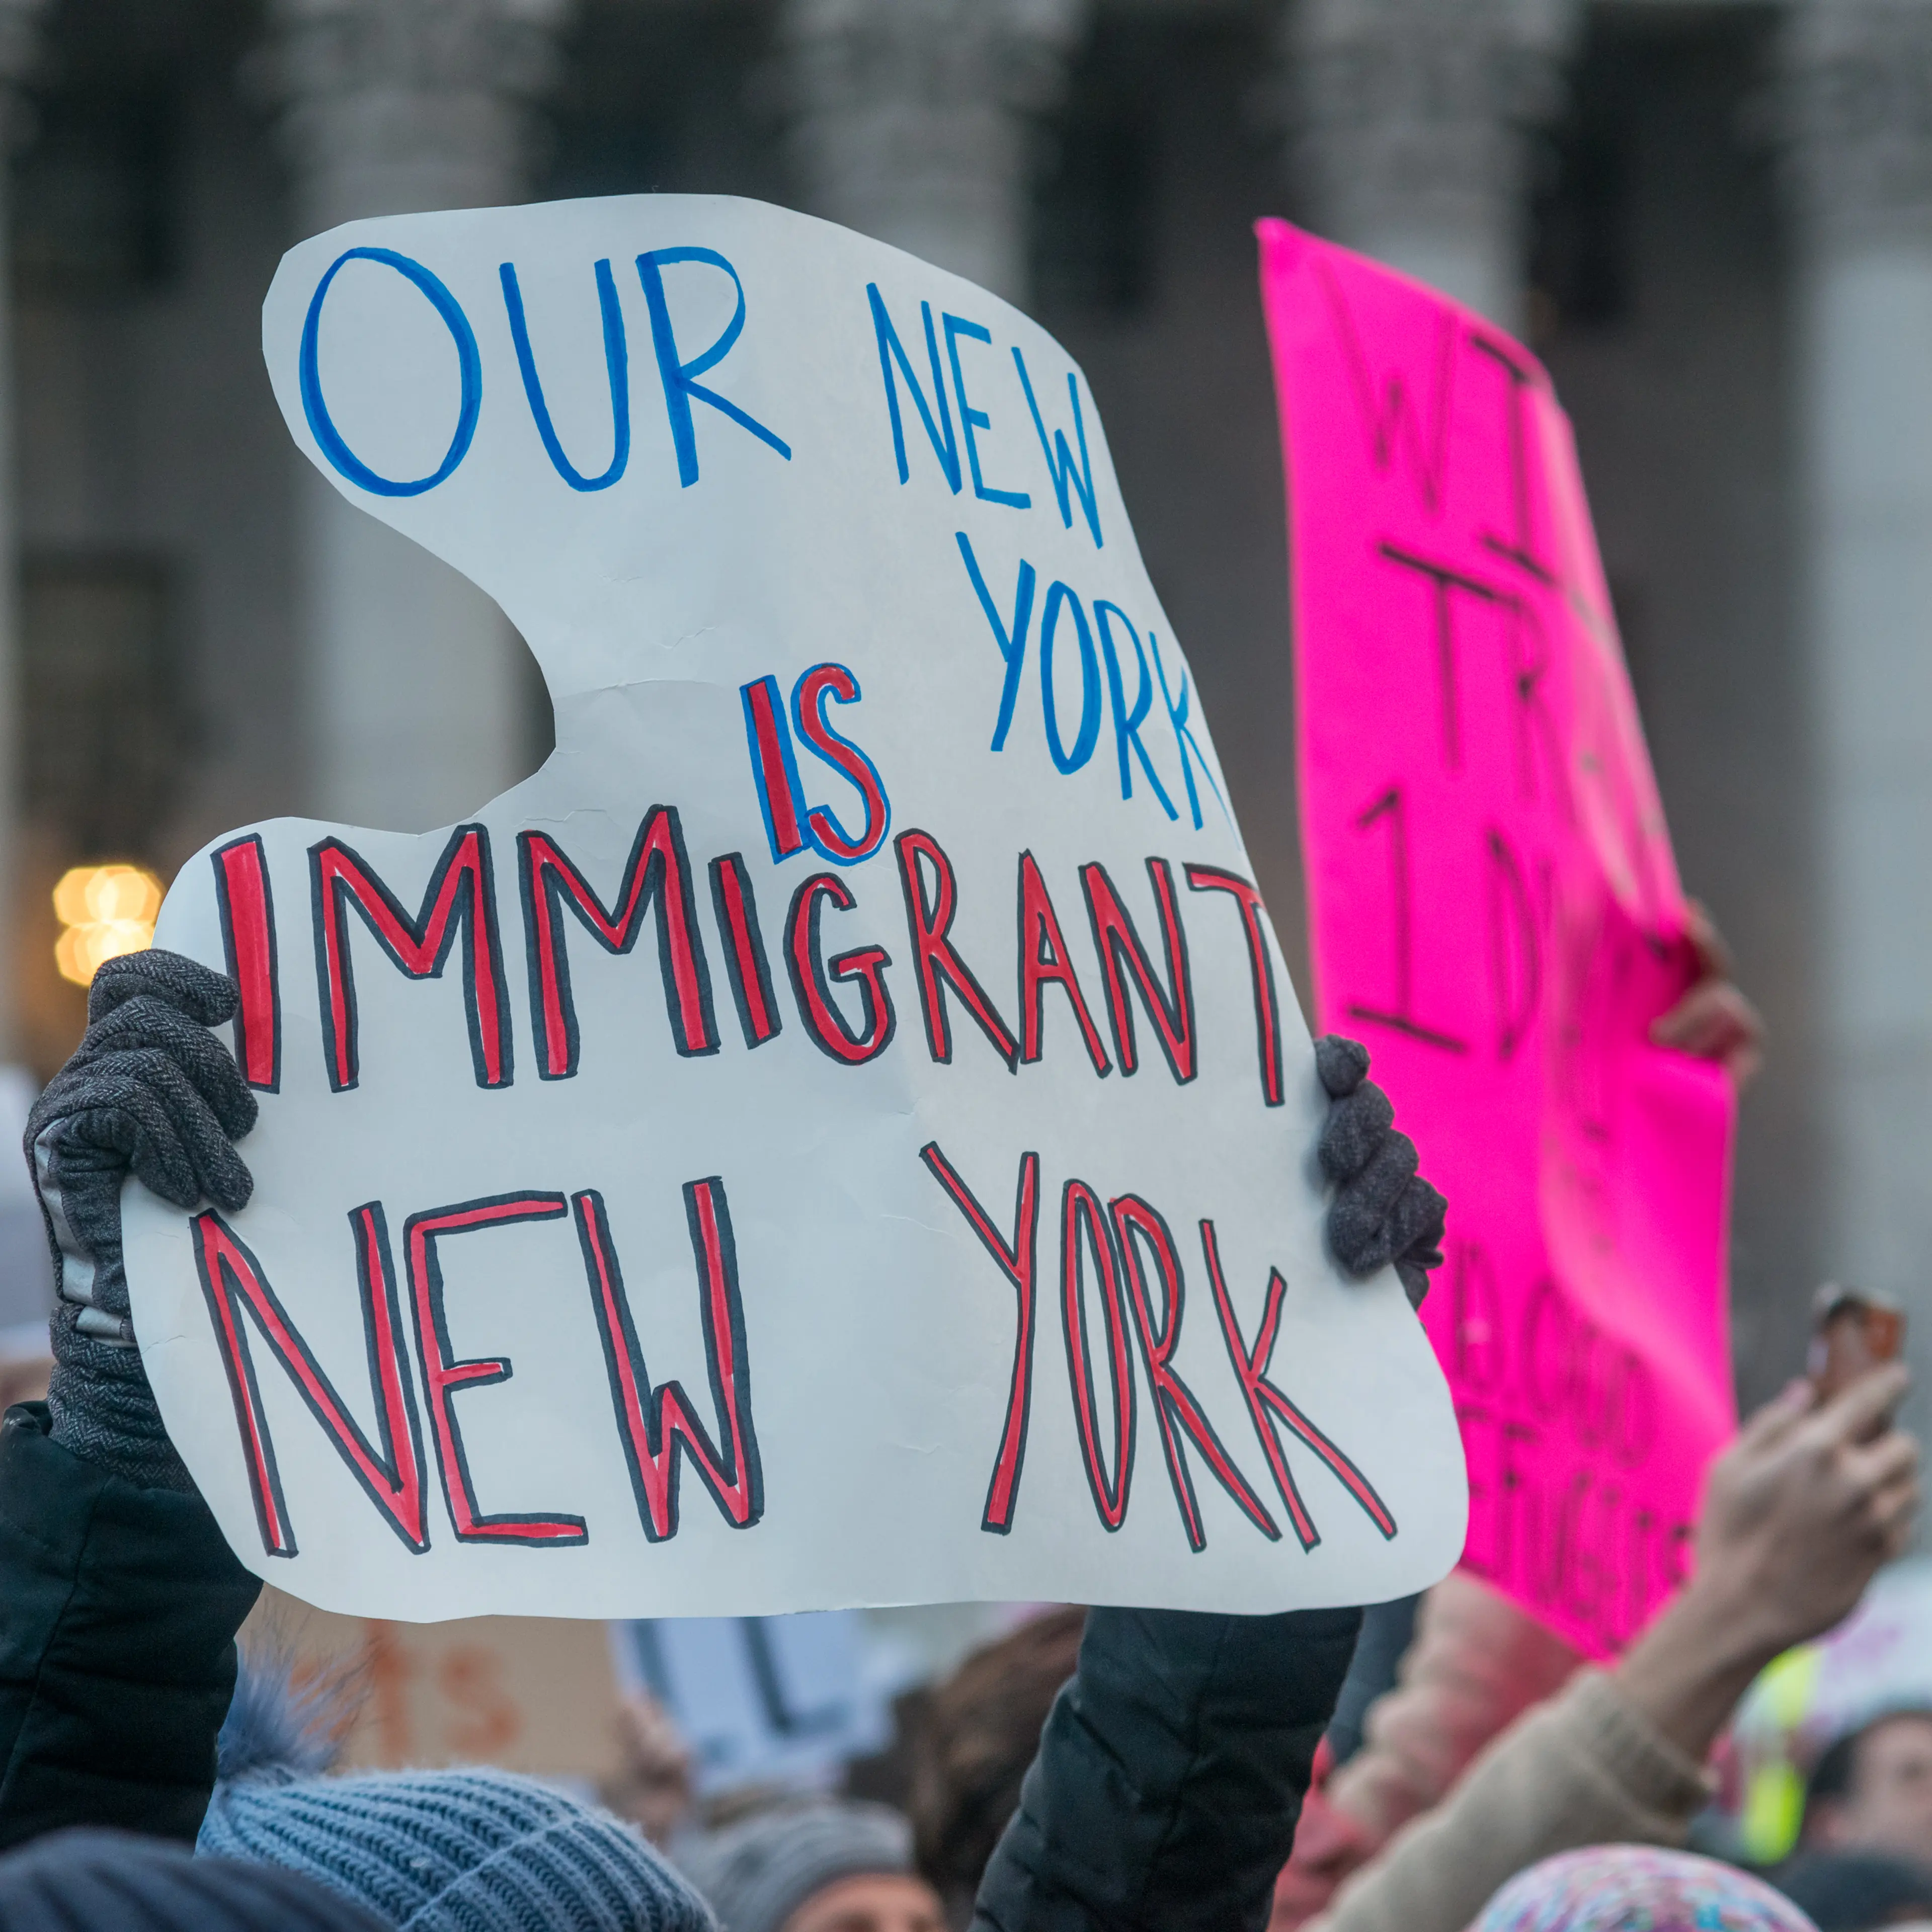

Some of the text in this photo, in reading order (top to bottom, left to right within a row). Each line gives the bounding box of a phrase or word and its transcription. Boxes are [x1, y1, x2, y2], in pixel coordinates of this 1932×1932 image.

[299, 246, 1103, 549] OUR NEW
[739, 662, 891, 867] IS
[954, 530, 1239, 848] YORK
[210, 804, 1285, 1108] IMMIGRANT
[188, 1175, 765, 1558] NEW
[919, 1140, 1400, 1555] YORK
